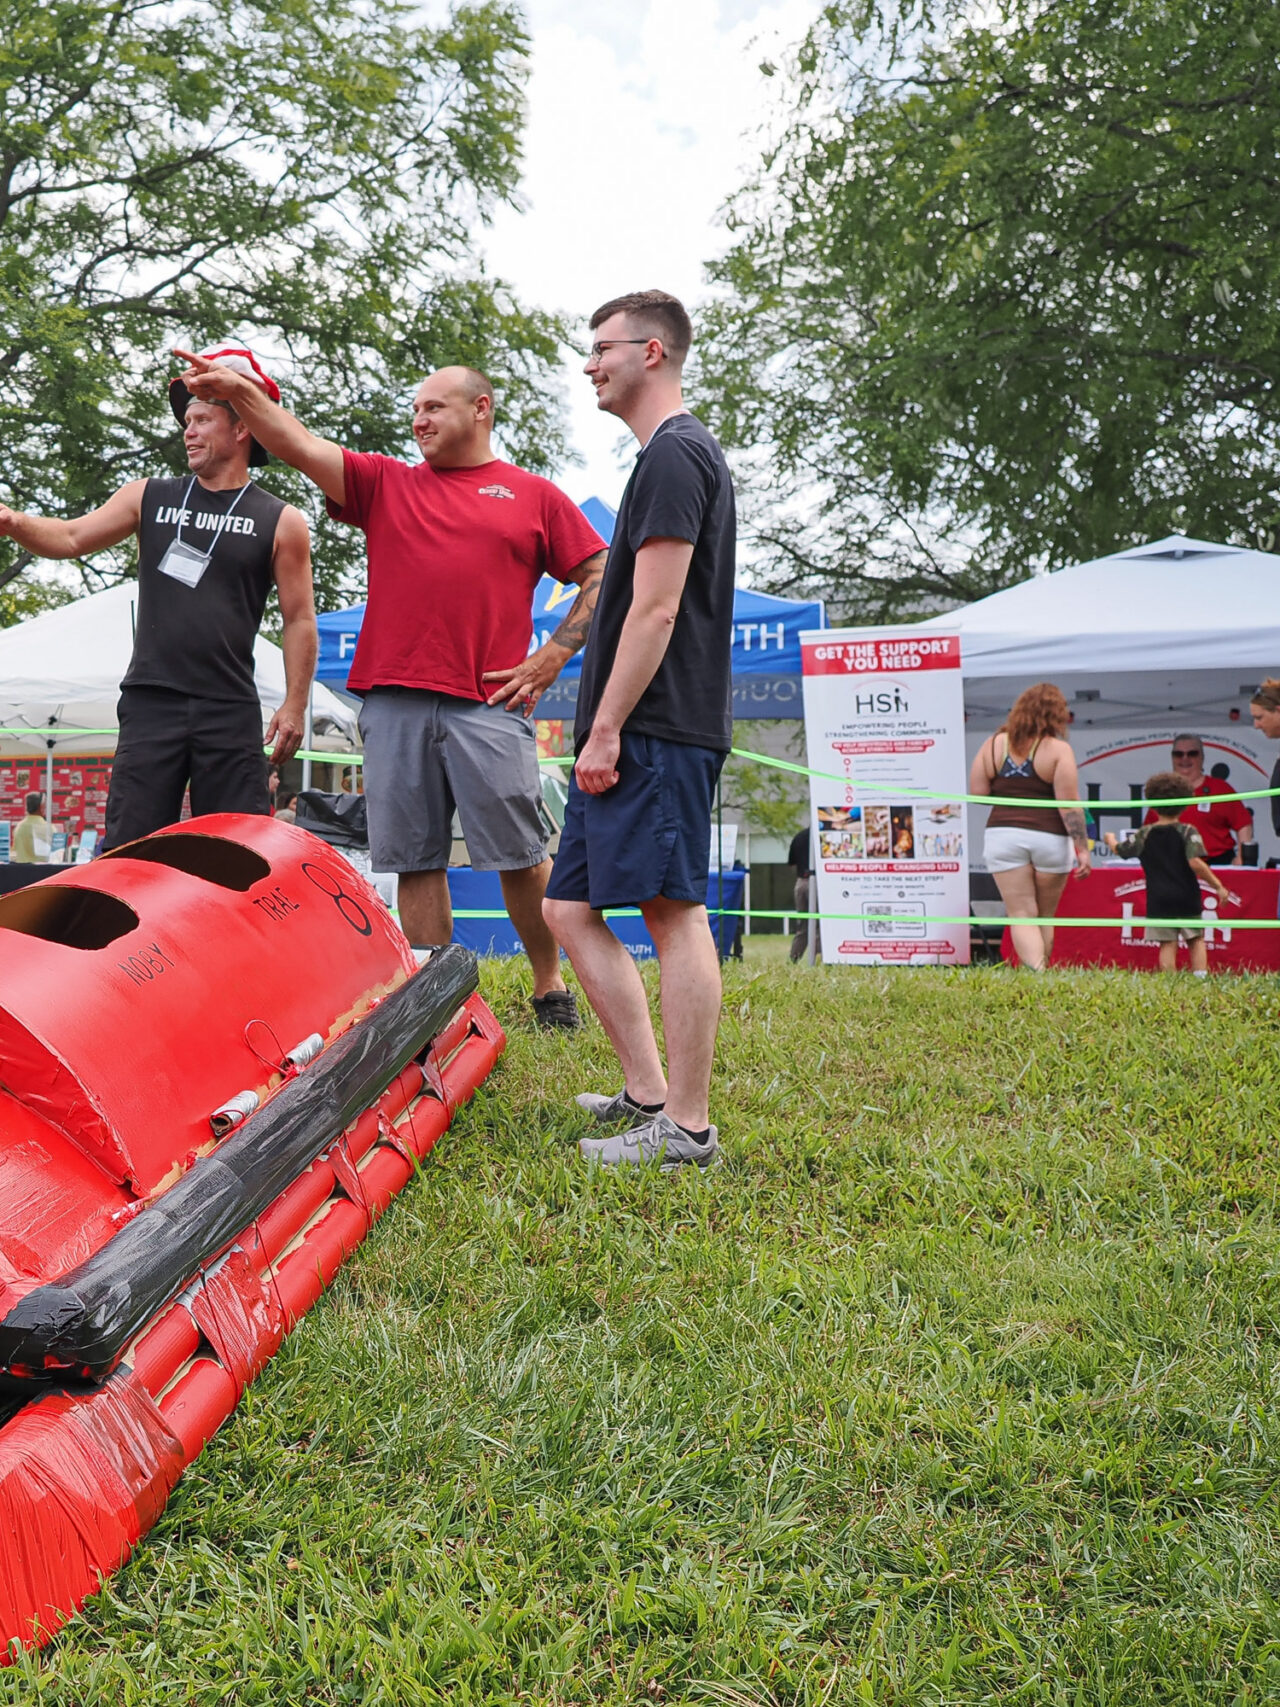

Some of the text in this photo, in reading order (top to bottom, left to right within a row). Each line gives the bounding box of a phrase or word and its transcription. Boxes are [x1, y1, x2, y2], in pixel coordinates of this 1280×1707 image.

[155, 506, 257, 536] LIVE UNITED.
[815, 640, 950, 660] GET THE SUPPORT
[844, 655, 922, 671] YOU NEED
[842, 720, 927, 730] EMPOWERING PEOPLE
[891, 728, 947, 736] COMMUNITIES
[252, 887, 300, 921] TRAE
[301, 862, 373, 937] 8
[118, 942, 174, 986] NOBY
